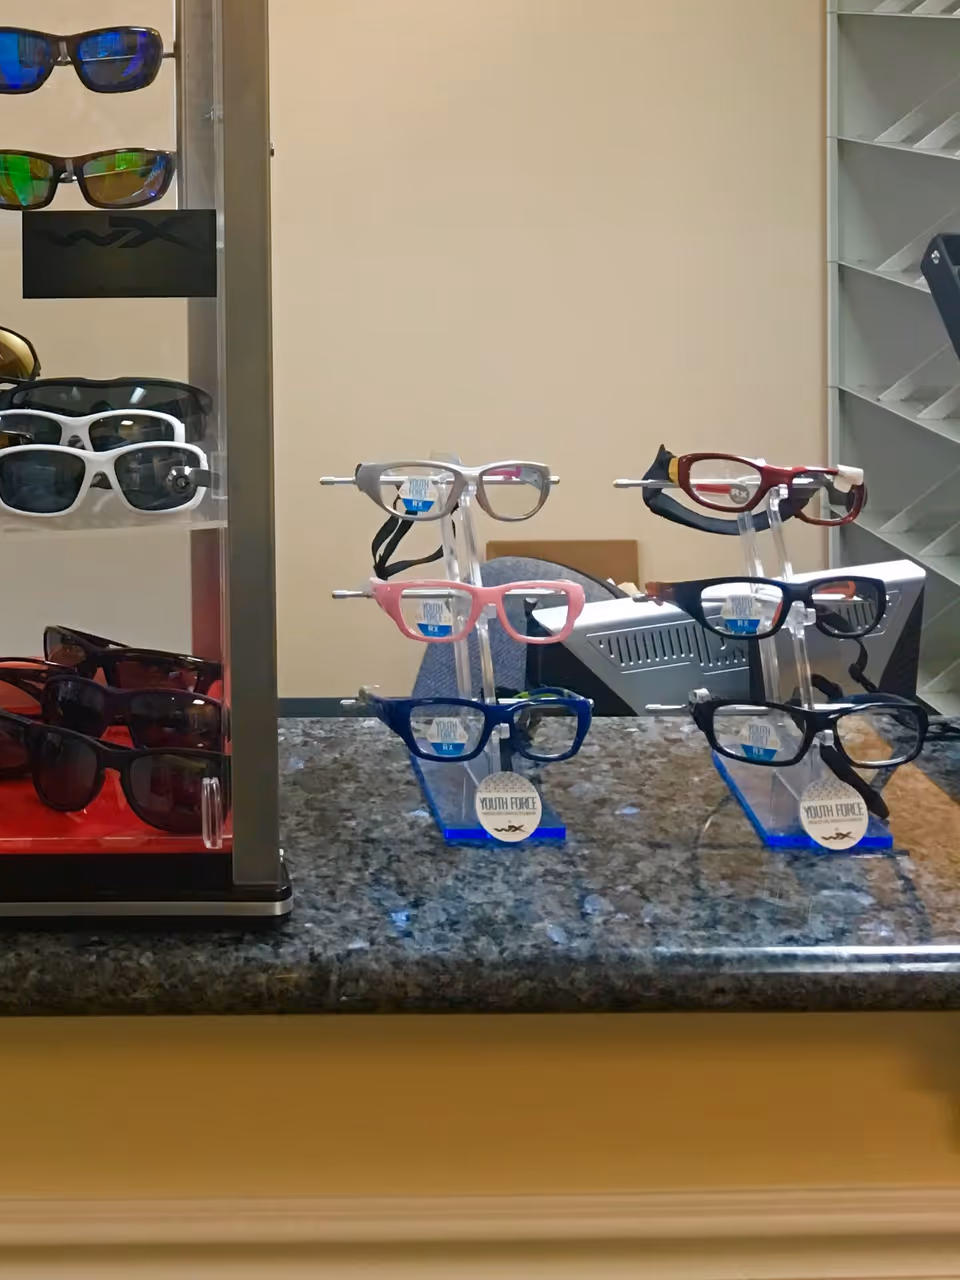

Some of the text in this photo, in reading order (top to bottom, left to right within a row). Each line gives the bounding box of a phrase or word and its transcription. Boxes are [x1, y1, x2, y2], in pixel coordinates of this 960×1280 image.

[480, 796, 537, 811] YOUTH FORCE
[804, 802, 864, 819] YOUTH FORCE
